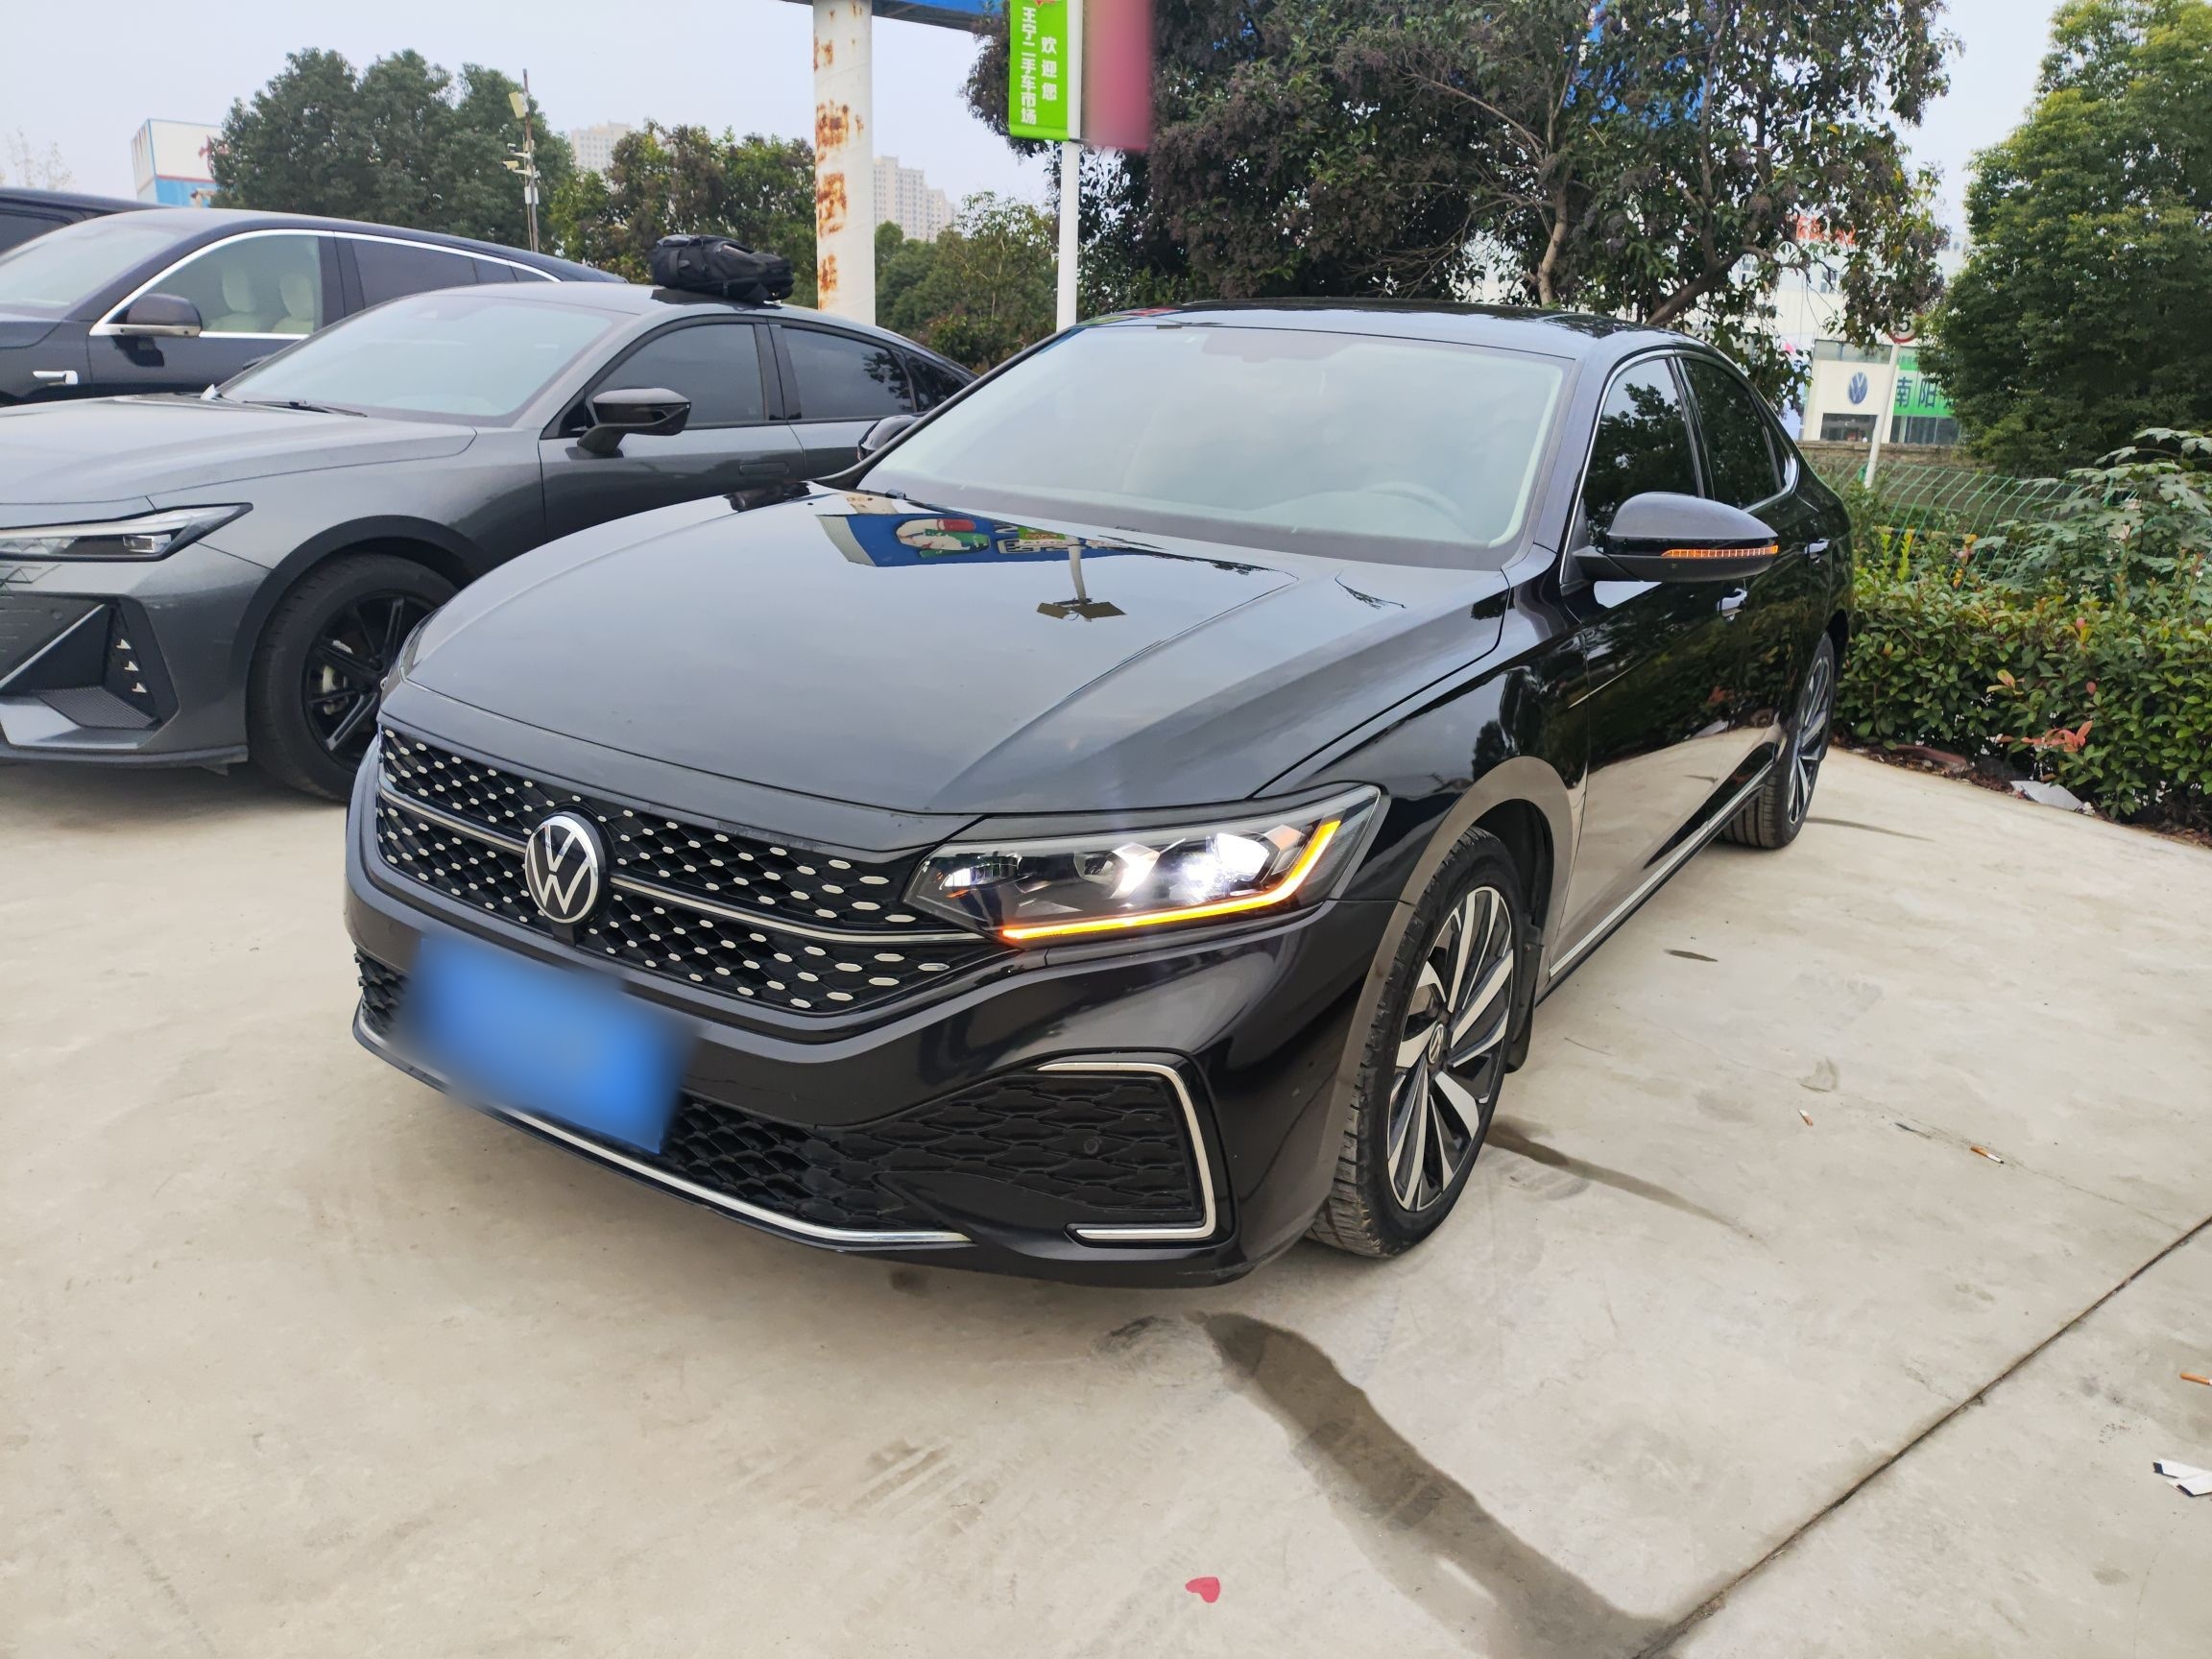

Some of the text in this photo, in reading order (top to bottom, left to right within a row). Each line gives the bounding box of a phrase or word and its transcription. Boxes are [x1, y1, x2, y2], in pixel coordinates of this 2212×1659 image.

[1022, 7, 1036, 125] 王宁二手车市场
[1042, 36, 1057, 101] 欢迎您
